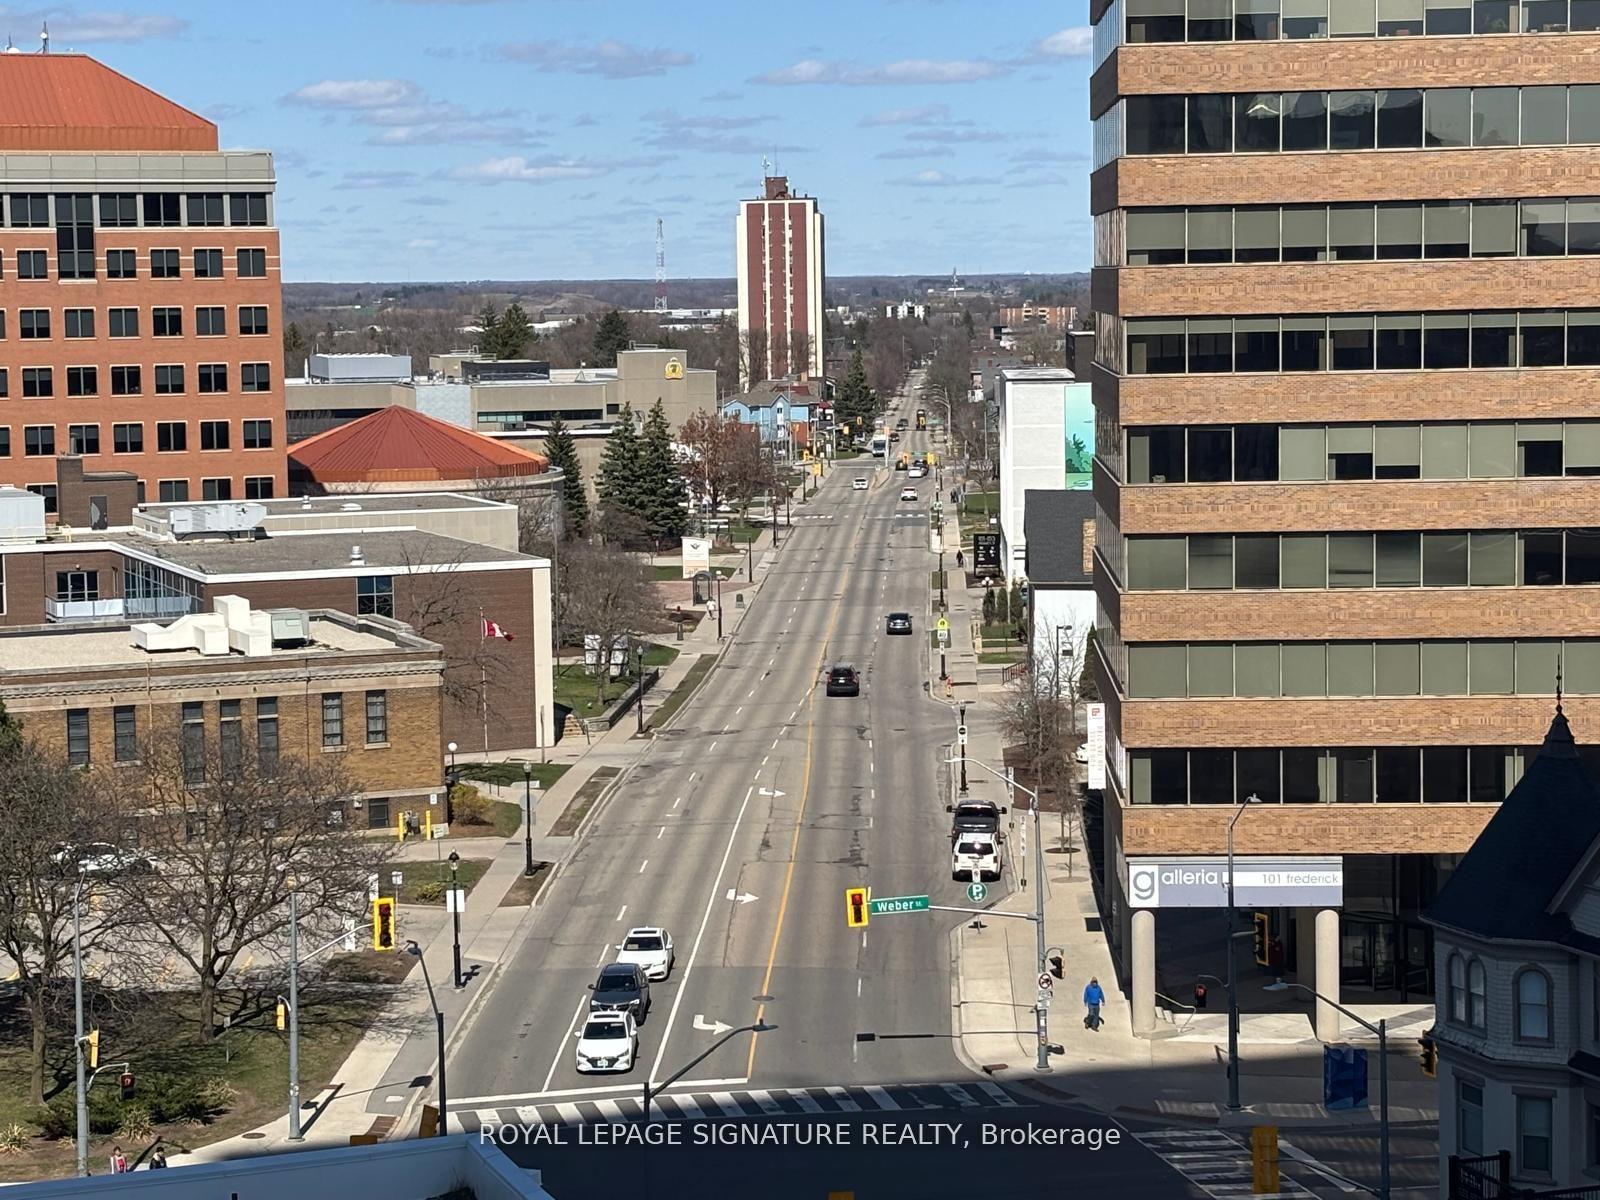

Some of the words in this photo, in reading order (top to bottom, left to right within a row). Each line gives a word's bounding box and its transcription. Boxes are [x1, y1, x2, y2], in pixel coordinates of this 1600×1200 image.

[1262, 874, 1281, 884] 101
[1287, 873, 1339, 884] frederick
[877, 901, 914, 912] Weber
